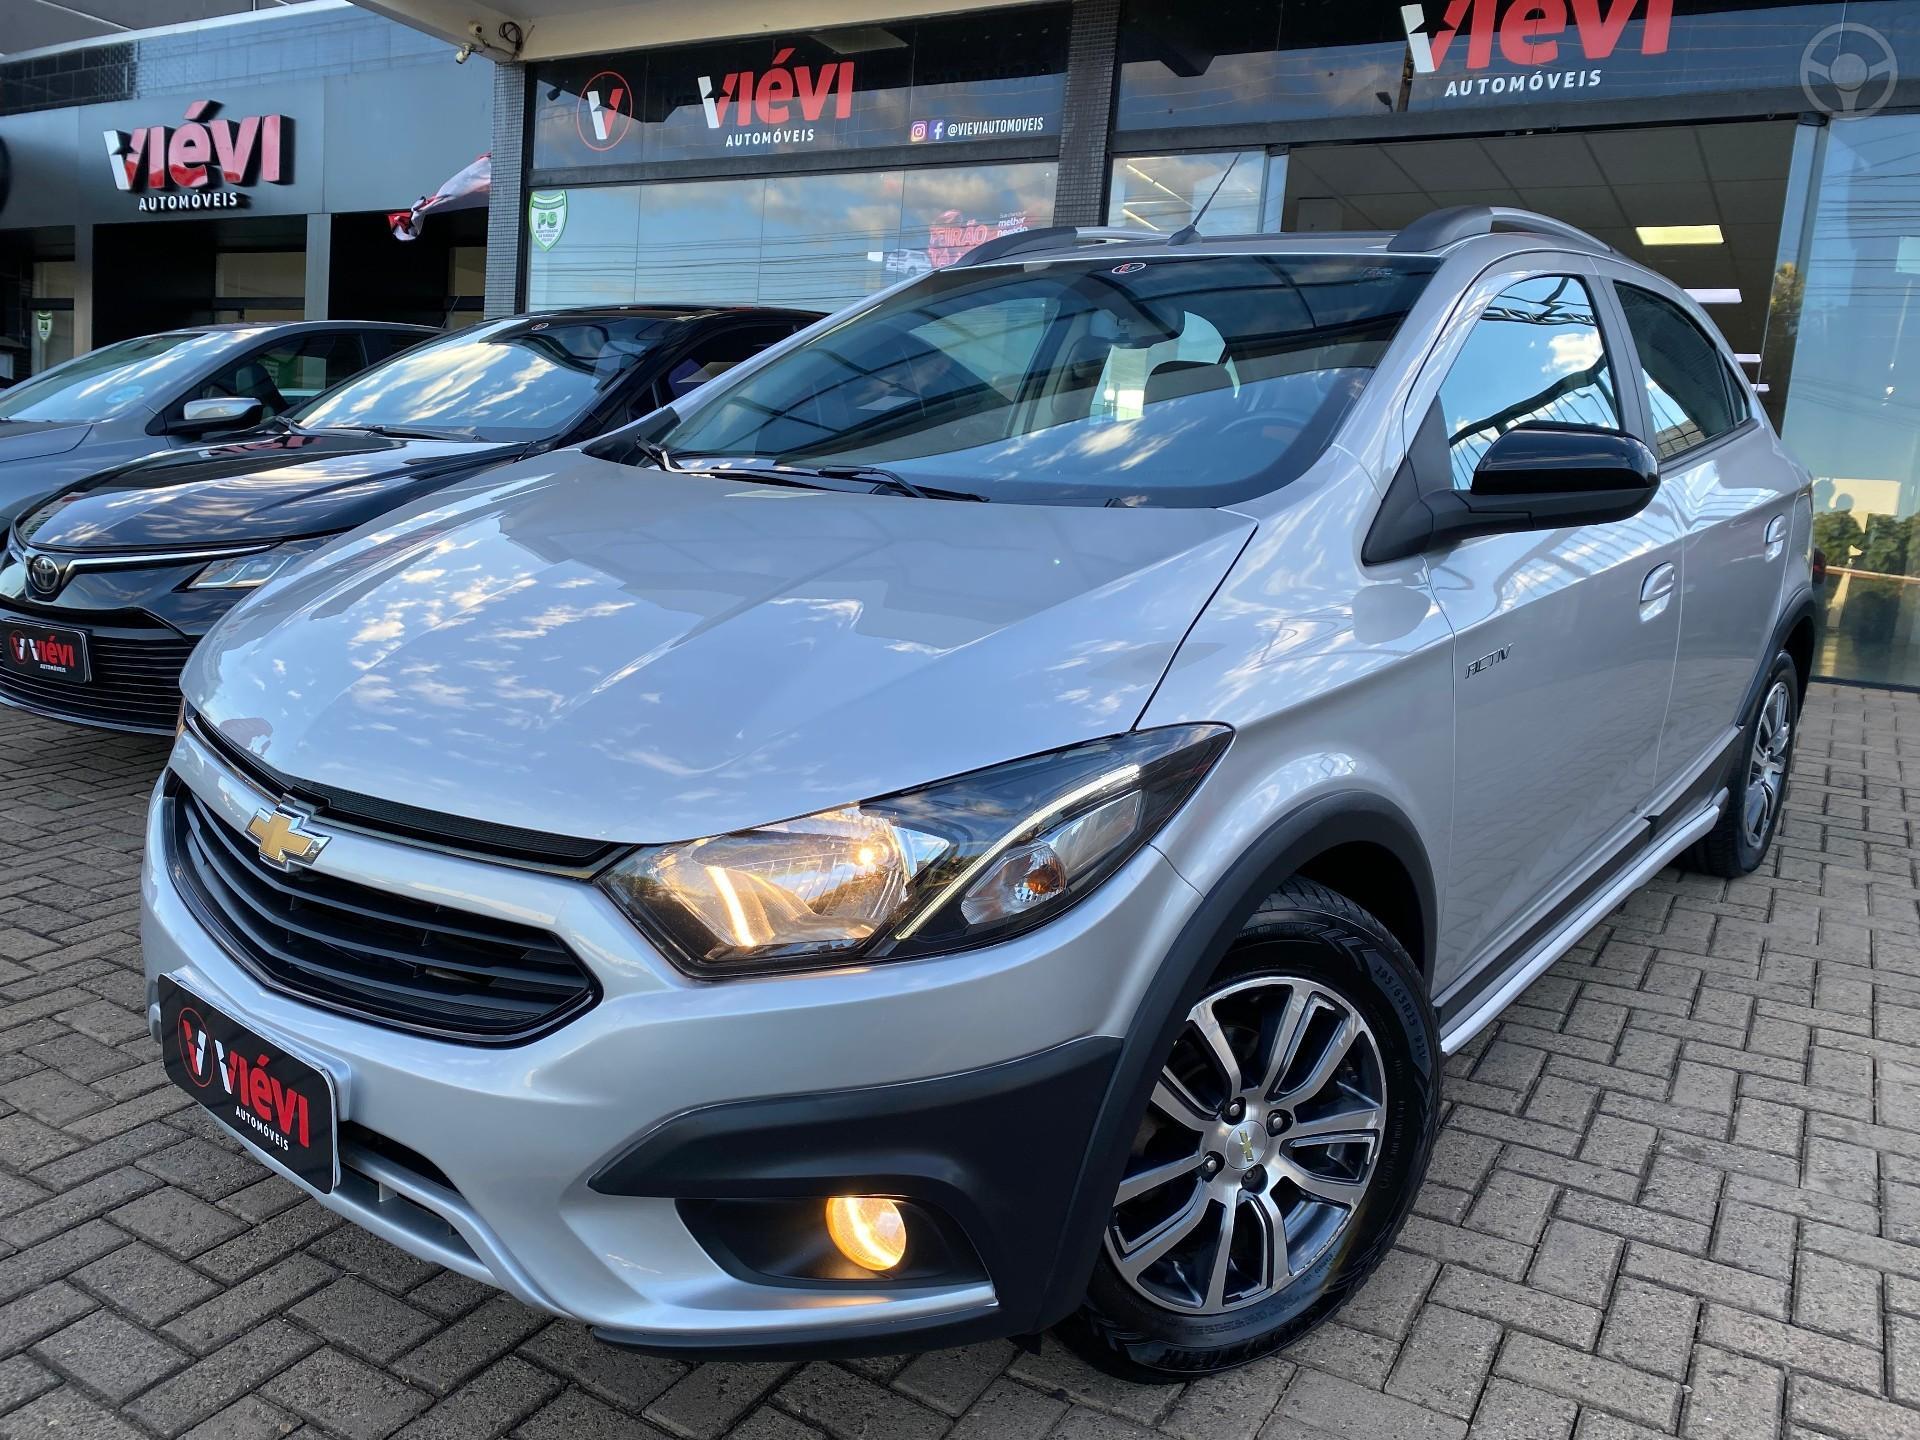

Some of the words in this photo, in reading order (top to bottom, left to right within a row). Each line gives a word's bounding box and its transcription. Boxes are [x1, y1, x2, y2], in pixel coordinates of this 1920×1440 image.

[1444, 70, 1602, 97] AUTOMÓVEIS
[725, 128, 815, 147] AUTOMÓVEIS
[947, 117, 1044, 137] @VIEVIAUTOMOVEIS
[138, 189, 238, 211] AUTOMÓVEIS
[236, 1105, 289, 1151] AUTOMÓVEIS
